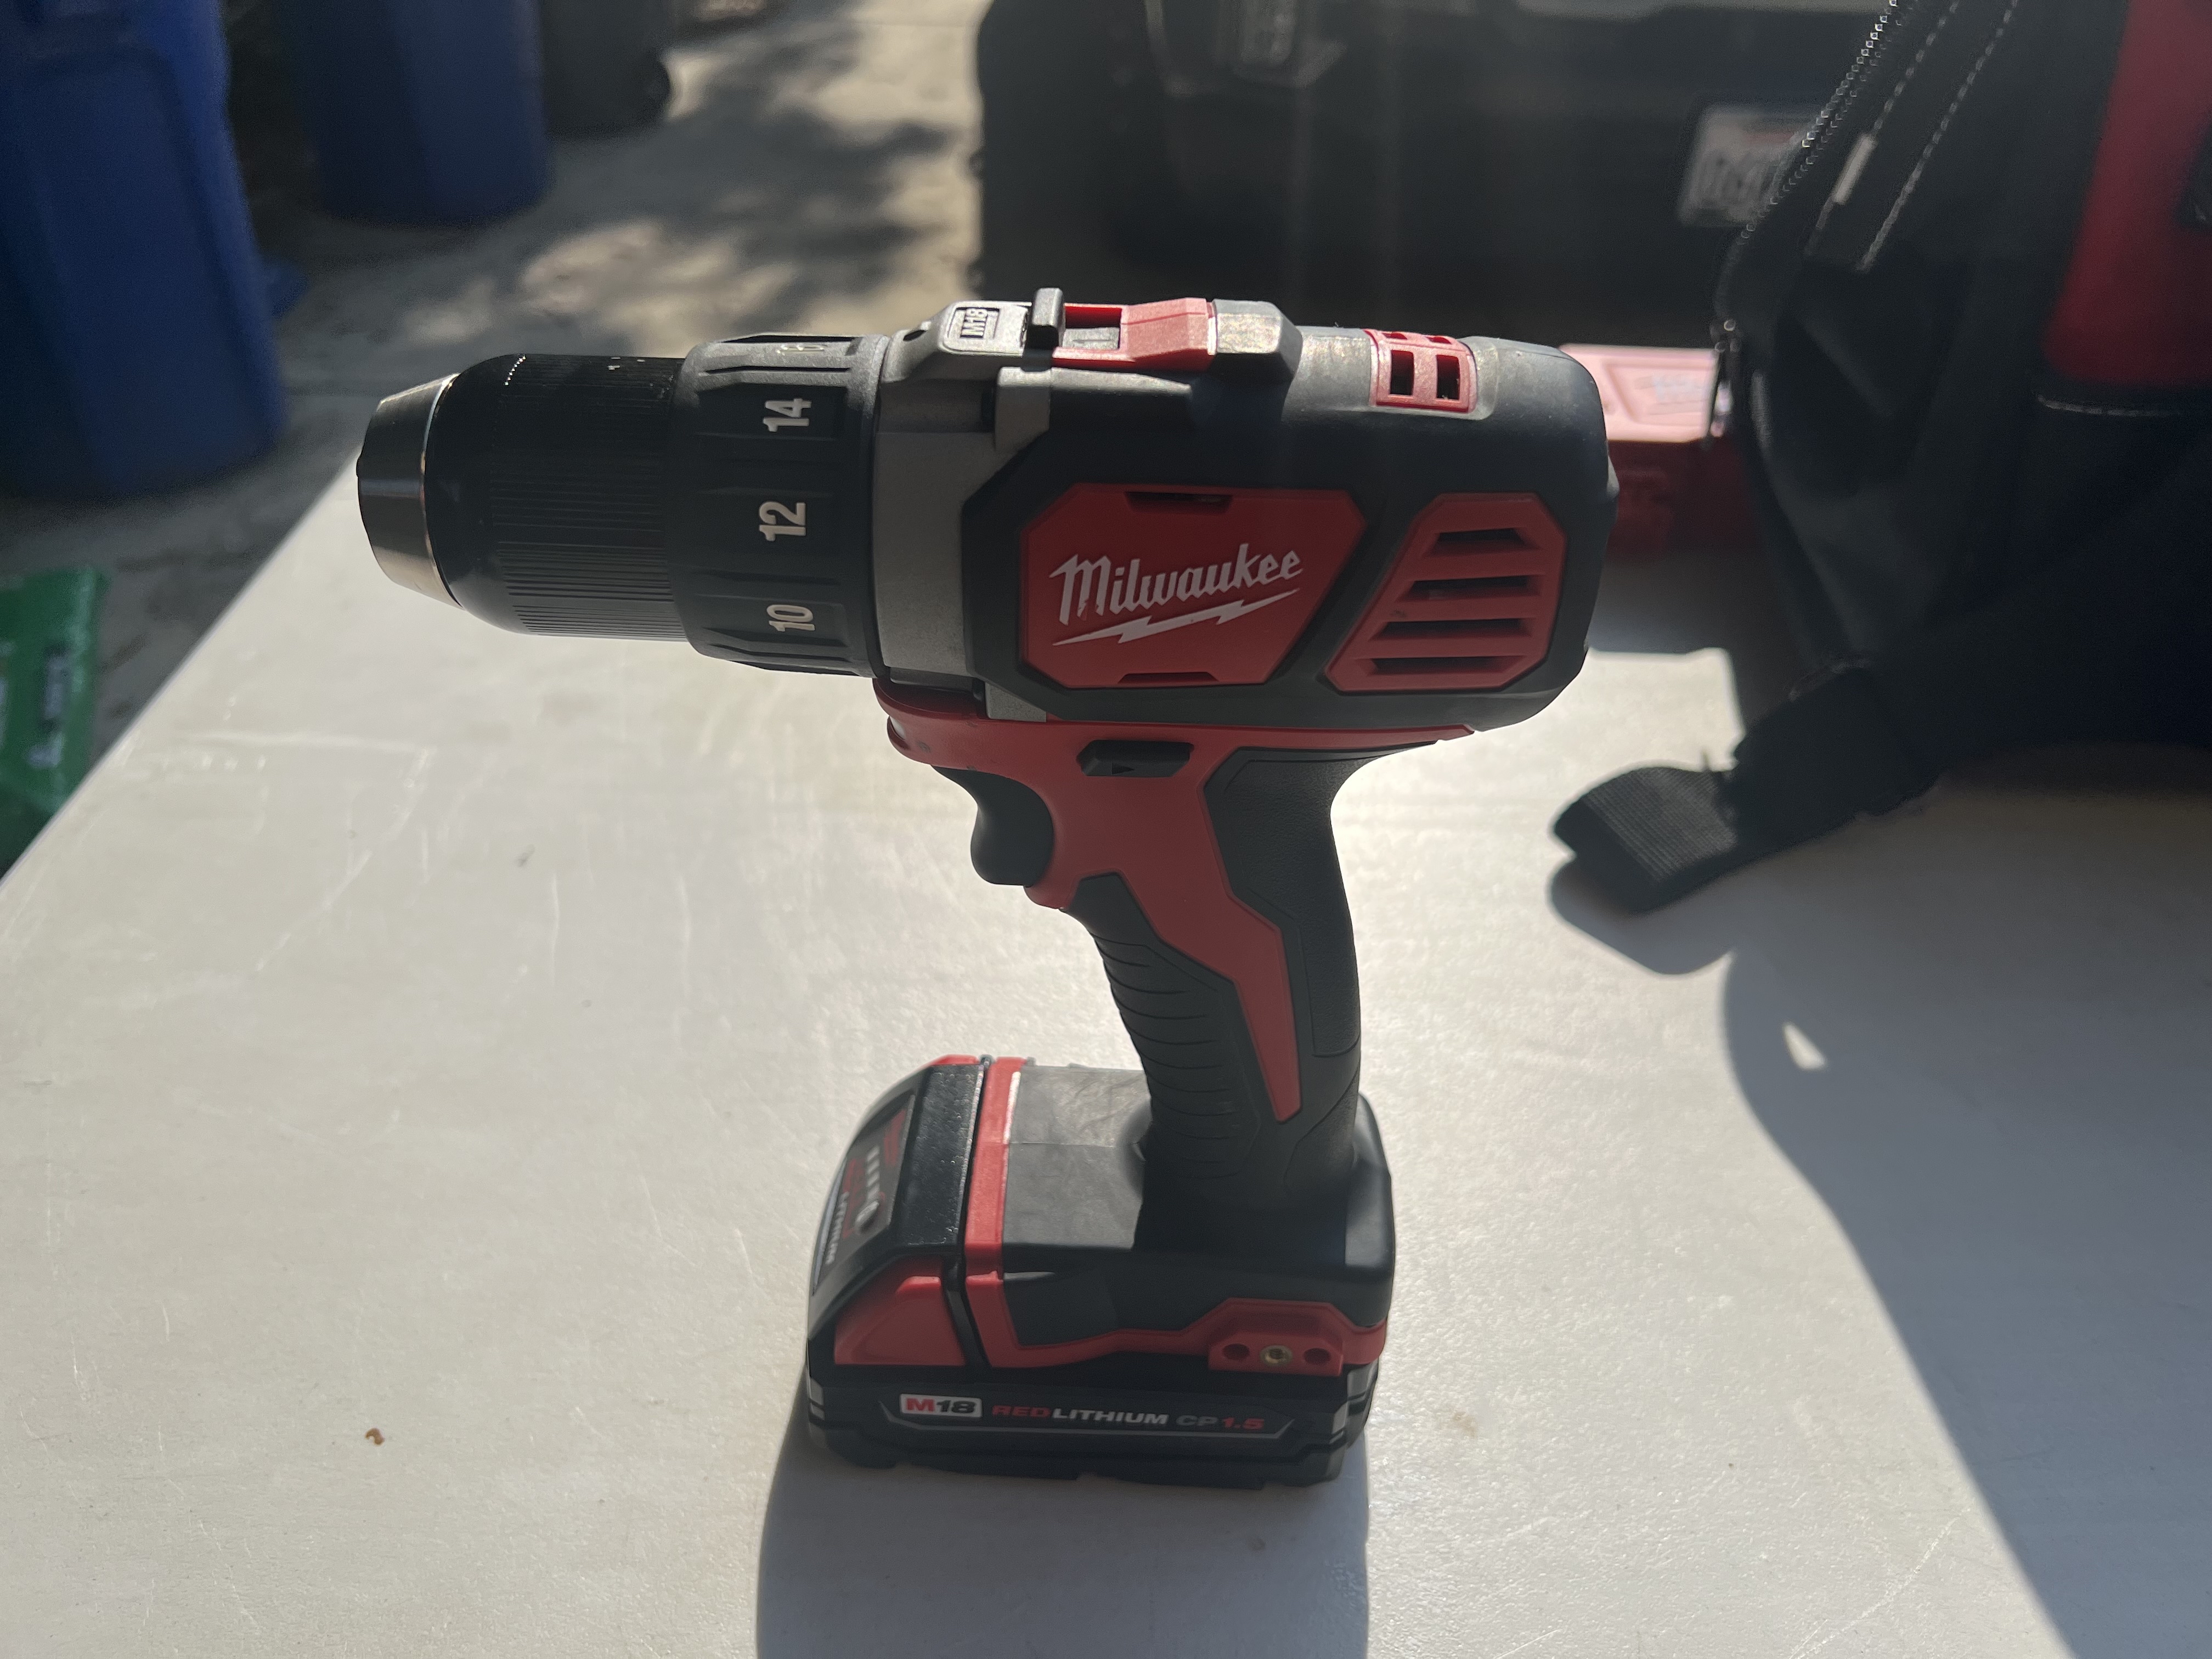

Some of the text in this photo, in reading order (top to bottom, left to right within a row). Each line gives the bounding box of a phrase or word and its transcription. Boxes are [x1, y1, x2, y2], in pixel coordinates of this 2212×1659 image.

[961, 308, 988, 336] M18
[763, 397, 812, 432] 14
[759, 501, 806, 542] 12
[1049, 543, 1304, 626] Milwaukee
[766, 604, 815, 632] 10
[906, 1397, 977, 1414] M18
[992, 1404, 1170, 1425] REDLITHIUM
